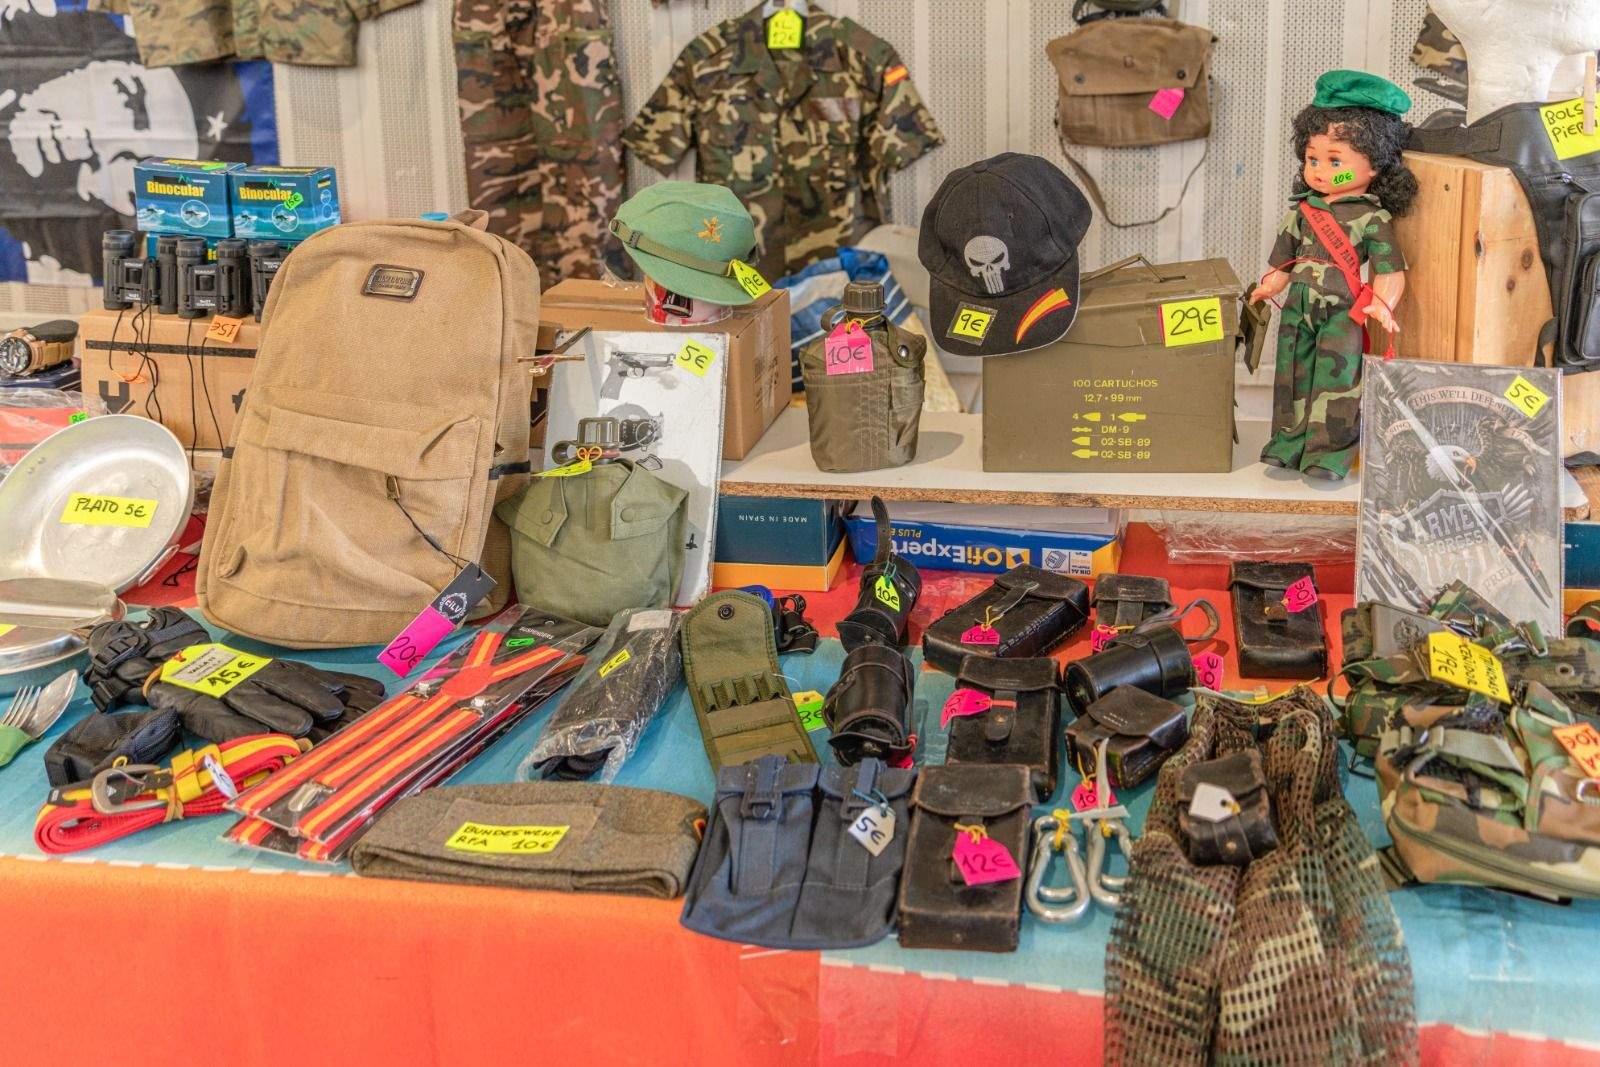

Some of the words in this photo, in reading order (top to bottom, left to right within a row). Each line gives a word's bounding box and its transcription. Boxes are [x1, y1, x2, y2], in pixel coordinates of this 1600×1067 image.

[1545, 103, 1598, 126] BOLS
[146, 181, 205, 198] Binocular
[239, 187, 292, 201] Binocular
[961, 313, 984, 332] 9€
[1170, 306, 1218, 336] 29€
[680, 345, 708, 369] 5€
[828, 344, 867, 367] 10€
[1073, 379, 1091, 388] 100
[1094, 379, 1159, 388] CARTUCHOS
[1110, 393, 1124, 402] 99
[1413, 392, 1436, 408] THIS
[1439, 389, 1467, 400] WE'LL
[1509, 383, 1540, 410] 5€
[1111, 413, 1116, 421] 1
[75, 497, 119, 513] PLATO
[124, 503, 147, 518] 5€
[739, 514, 765, 522] SPAIN
[769, 514, 779, 523] IN
[783, 514, 808, 523] MADE
[900, 528, 922, 538] PLUS
[890, 538, 1002, 566] OfiExpert
[877, 586, 899, 606] 10€
[1295, 581, 1315, 606] 10€
[387, 636, 424, 669] 20€
[1204, 656, 1219, 690] 0€
[856, 816, 886, 846] 5€
[511, 839, 554, 850] 10€
[962, 852, 1012, 875] 12€
